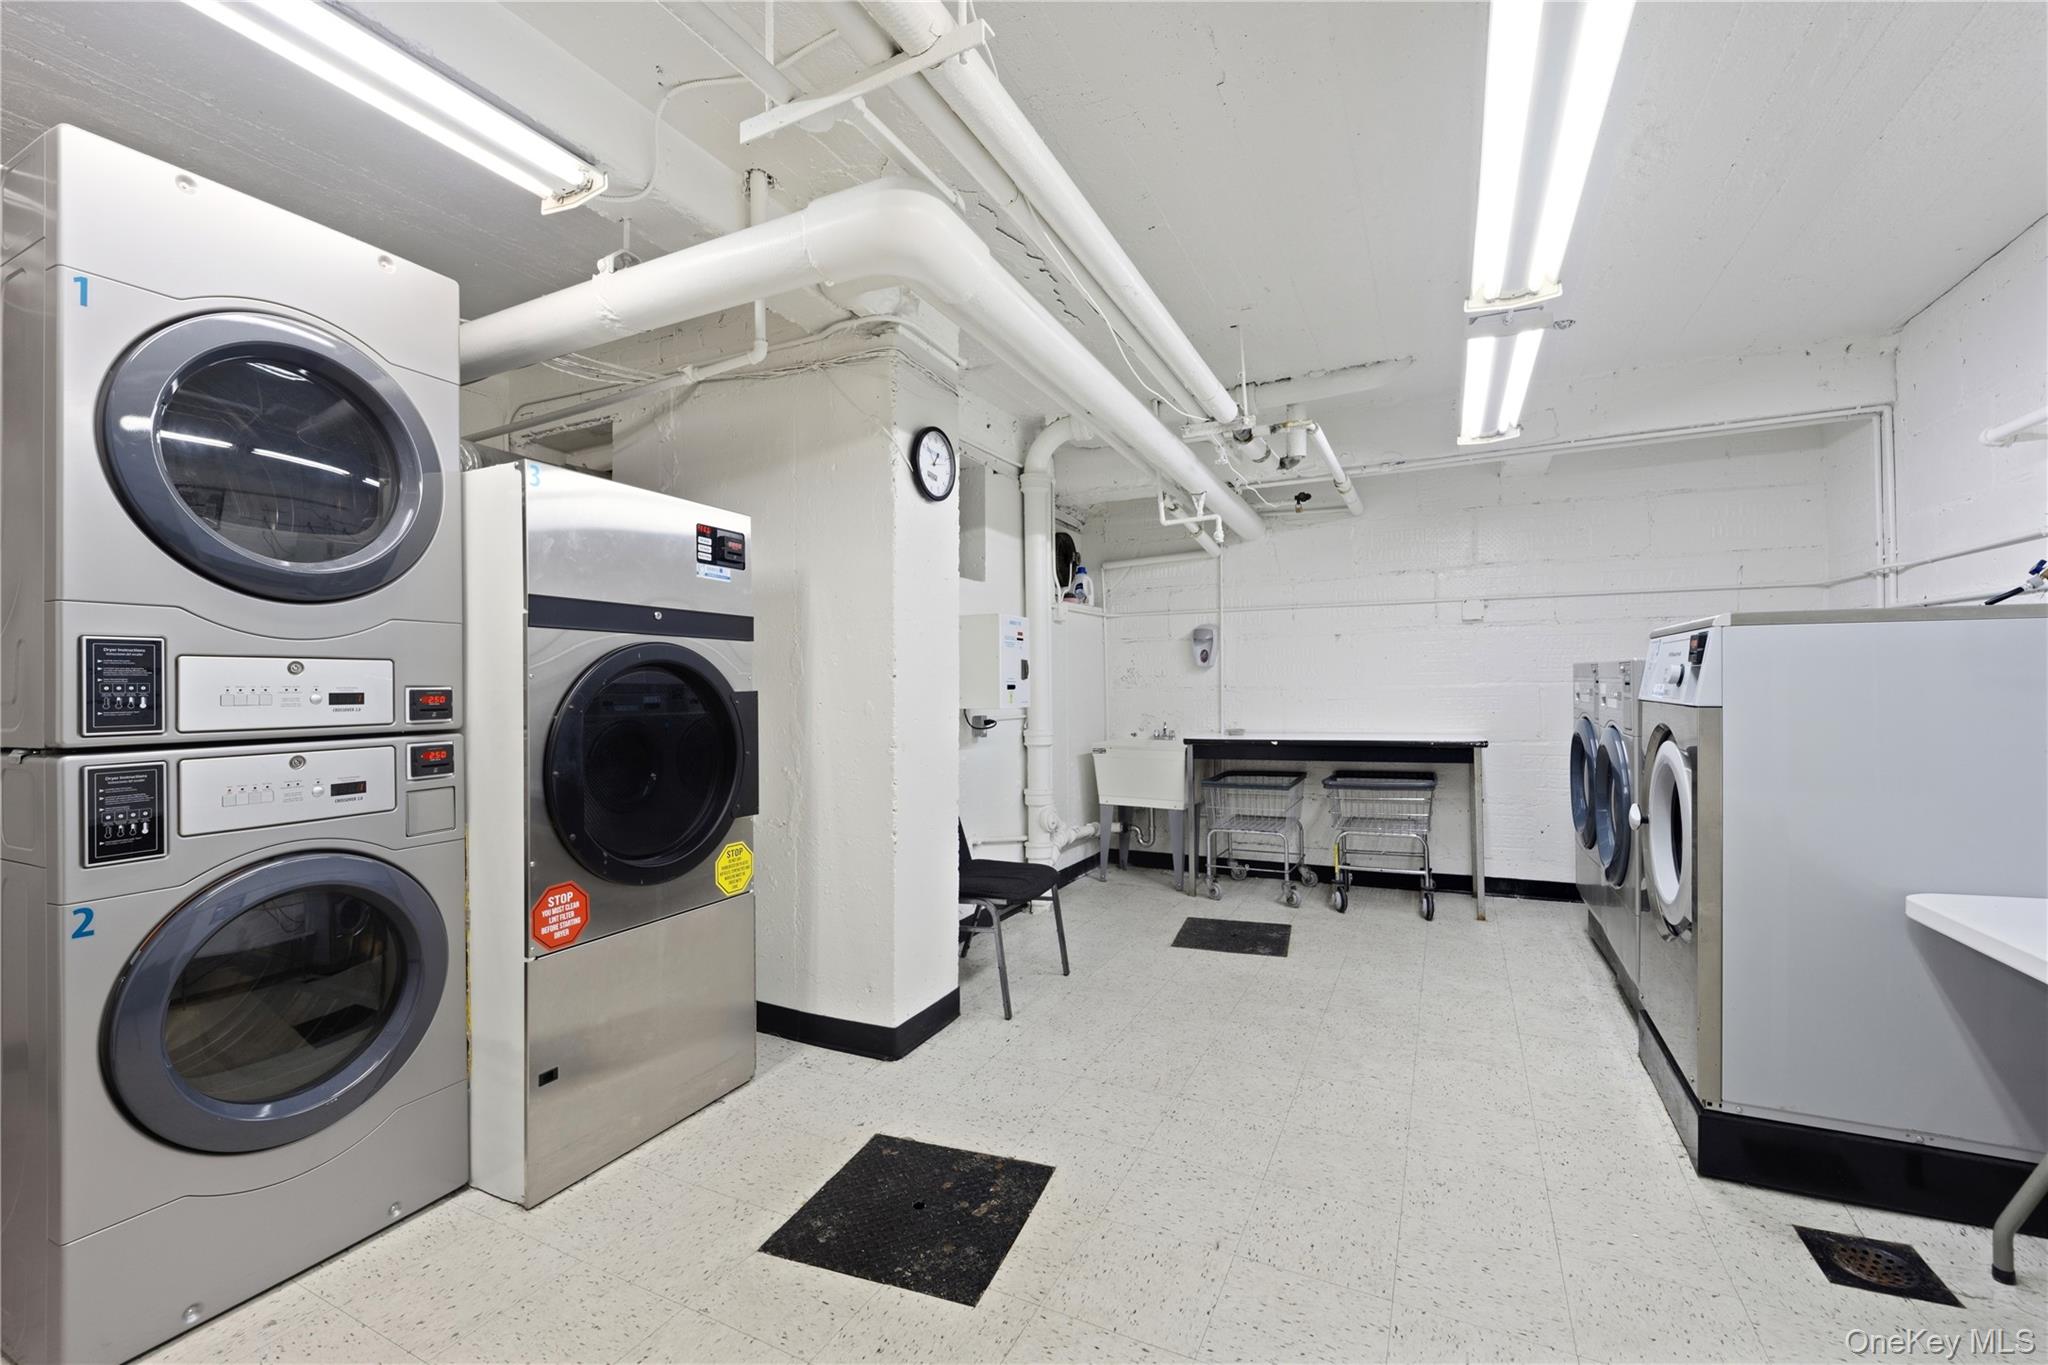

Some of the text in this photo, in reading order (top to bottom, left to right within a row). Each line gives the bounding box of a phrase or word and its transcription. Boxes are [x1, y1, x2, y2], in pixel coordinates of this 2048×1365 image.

[73, 276, 88, 307] 1
[529, 463, 541, 488] 3
[726, 848, 743, 858] STOP
[548, 892, 574, 908] STOP
[542, 908, 552, 918] YOU
[552, 904, 564, 914] MUST
[548, 910, 574, 924] LINT FILTER
[71, 907, 95, 939] 2
[542, 924, 558, 934] BEFORE
